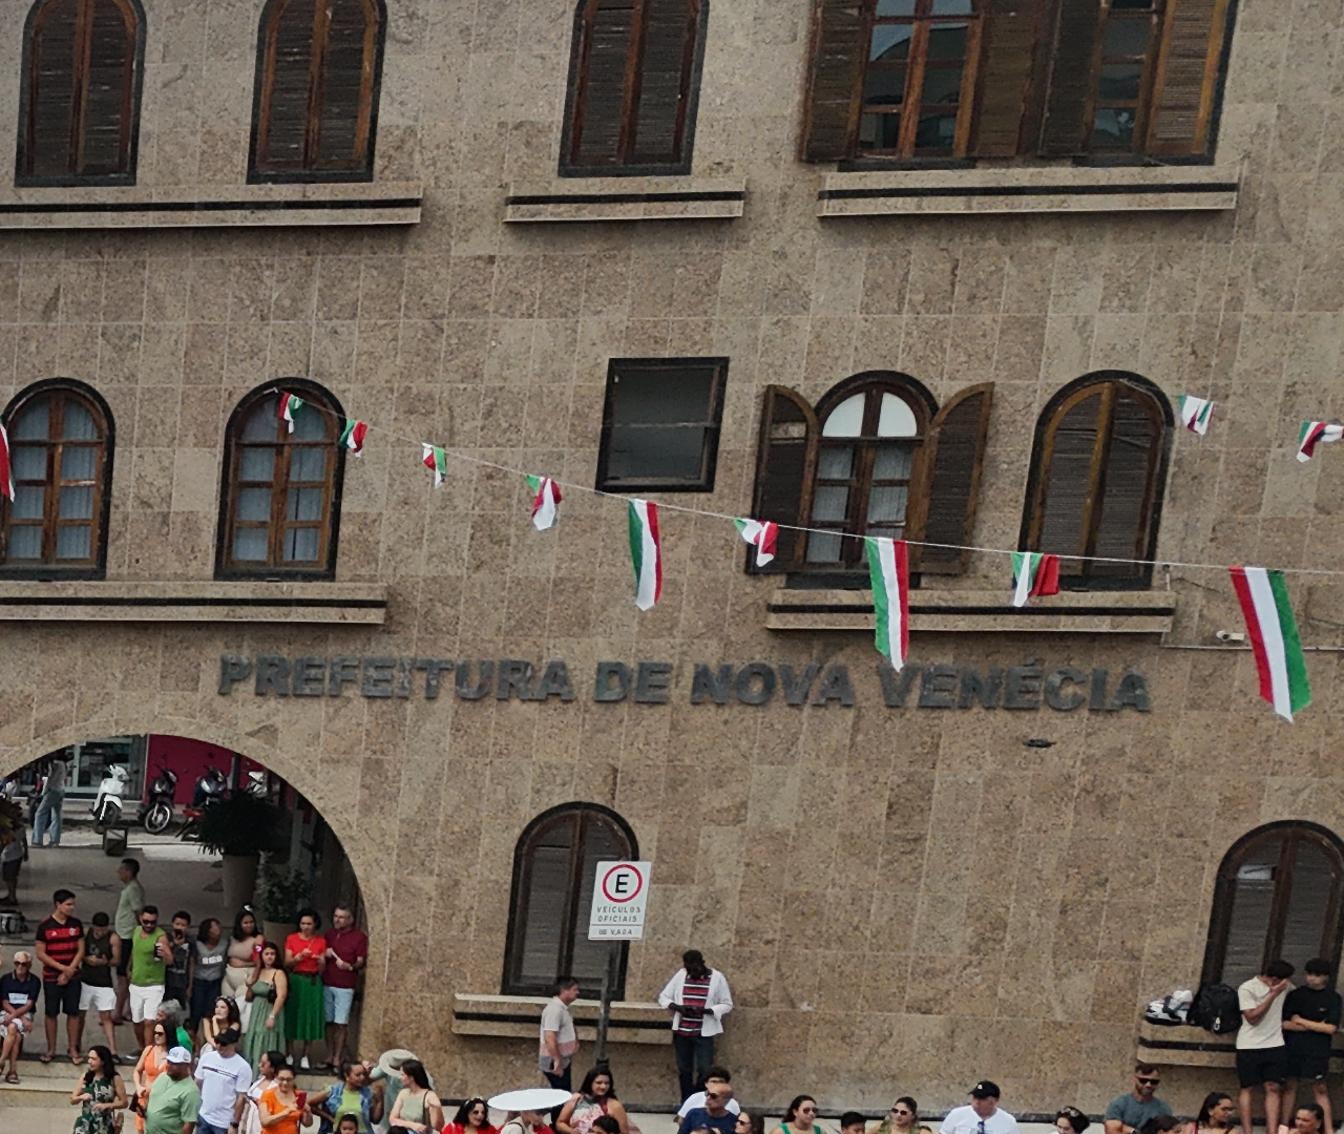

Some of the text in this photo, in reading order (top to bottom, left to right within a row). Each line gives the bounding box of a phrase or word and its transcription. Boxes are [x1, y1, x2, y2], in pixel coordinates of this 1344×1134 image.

[217, 654, 1152, 713] PREFEITURA DE NOVA VENÉCIA
[615, 873, 629, 893] E
